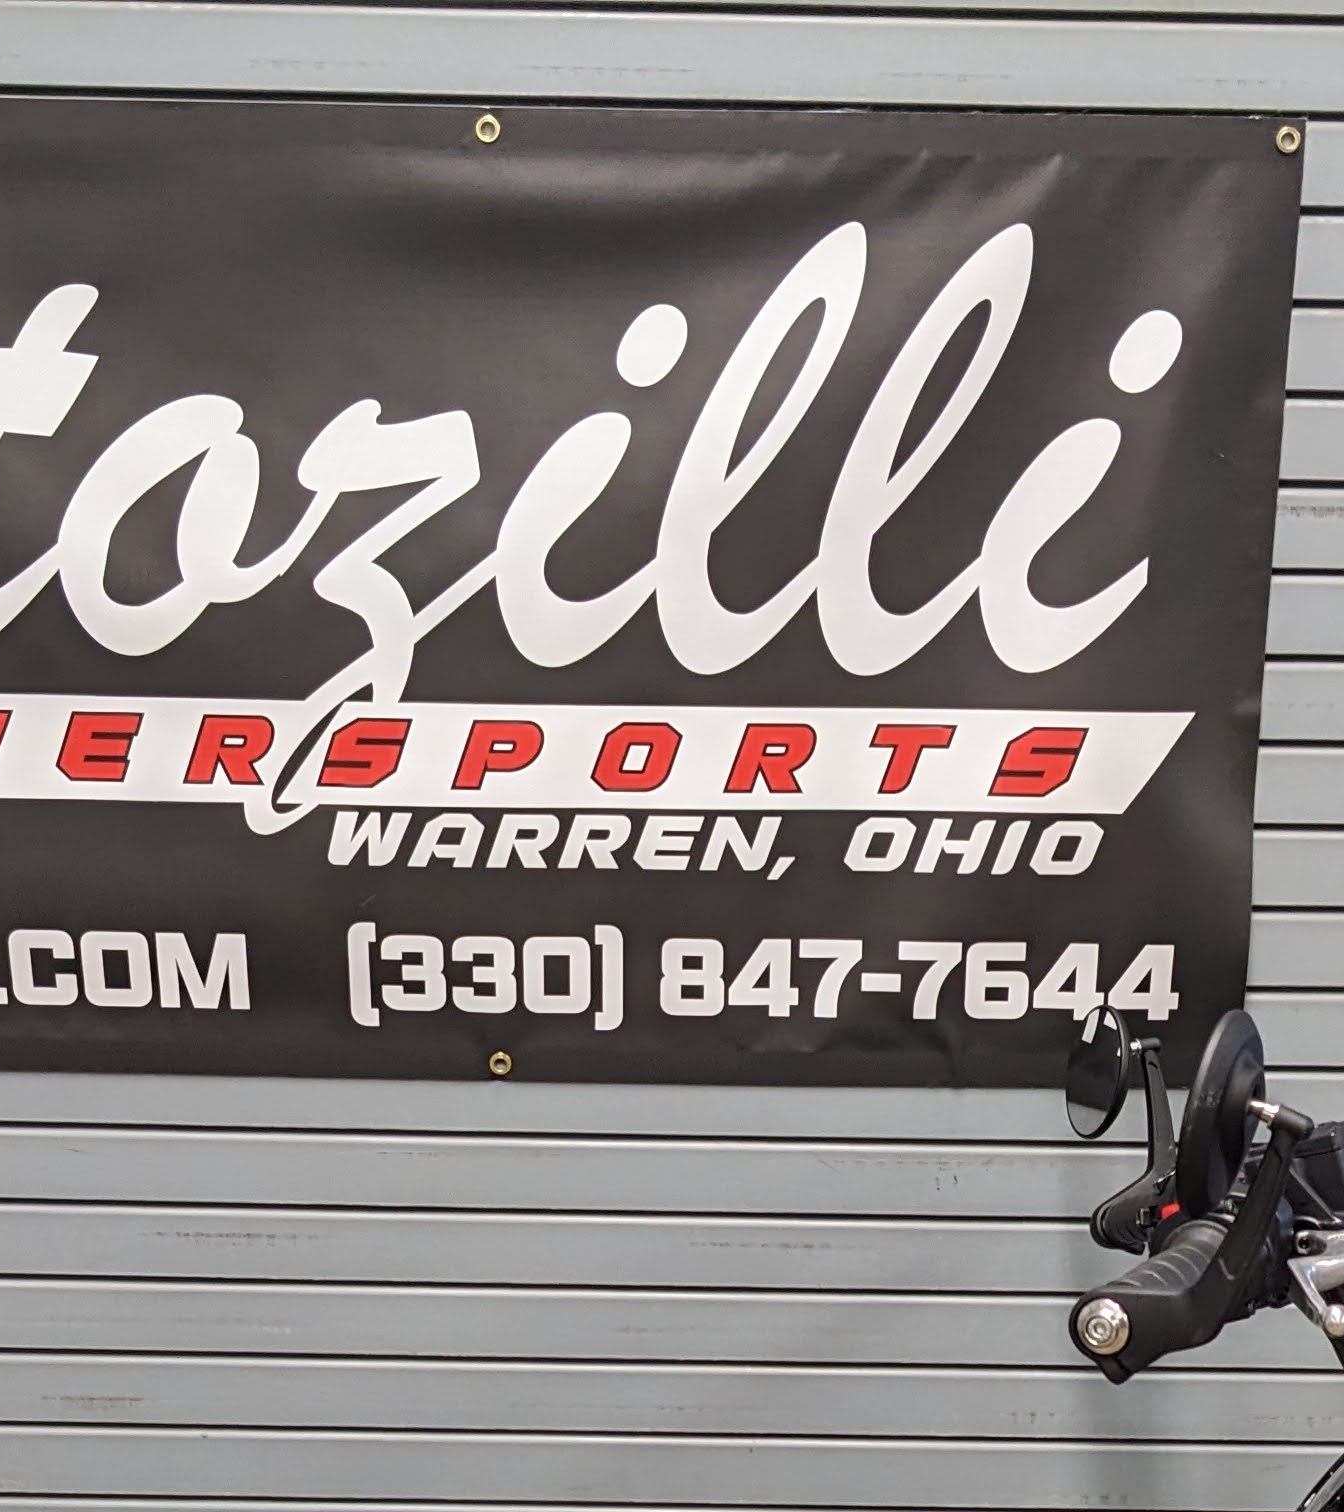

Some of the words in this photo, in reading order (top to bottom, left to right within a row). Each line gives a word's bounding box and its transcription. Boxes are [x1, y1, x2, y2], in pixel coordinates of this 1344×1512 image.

[327, 810, 796, 880] WARREN,
[843, 816, 1105, 876] OHIO
[347, 921, 624, 1031] (330)
[659, 937, 1180, 1021] 847-7644
